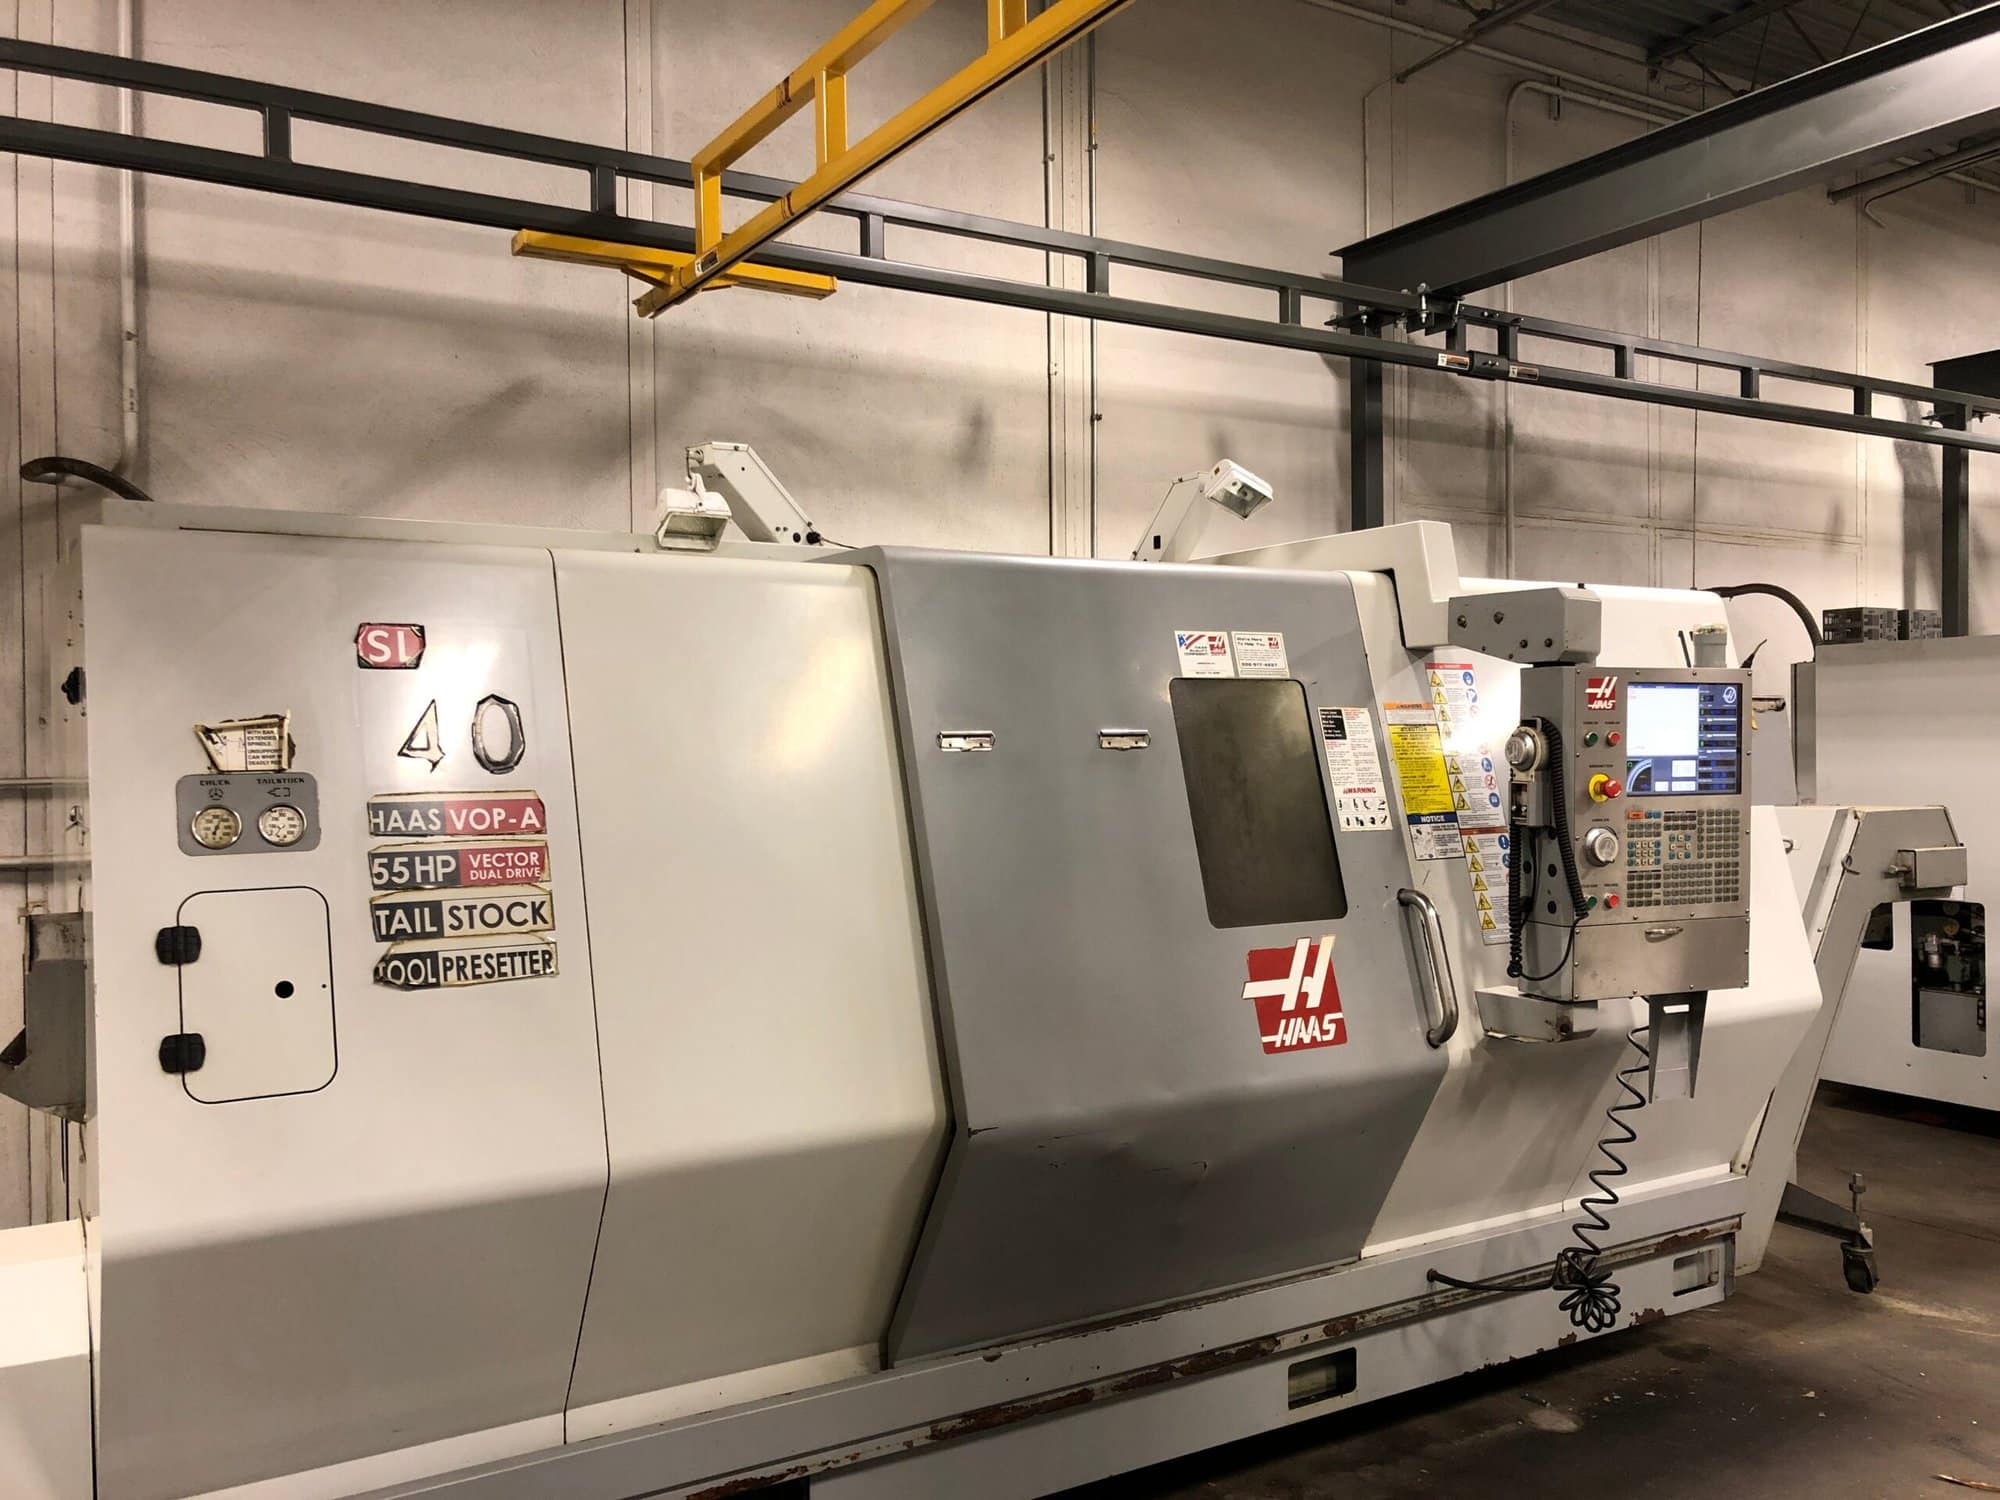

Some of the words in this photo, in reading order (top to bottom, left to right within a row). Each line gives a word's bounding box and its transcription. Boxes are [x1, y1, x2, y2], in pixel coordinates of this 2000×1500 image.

[1587, 700, 1617, 710] HAAS
[256, 777, 305, 785] TAILSTOCK
[369, 808, 442, 832] HAAS
[1420, 815, 1446, 823] NOTICE
[468, 852, 540, 869] VECTOR
[470, 869, 503, 881] DUAL
[505, 867, 541, 879] DRIVE
[375, 908, 438, 936] TAIL
[447, 899, 550, 932] STOCK
[442, 949, 555, 983] PRESETTER
[1261, 1012, 1345, 1048] HAAS
